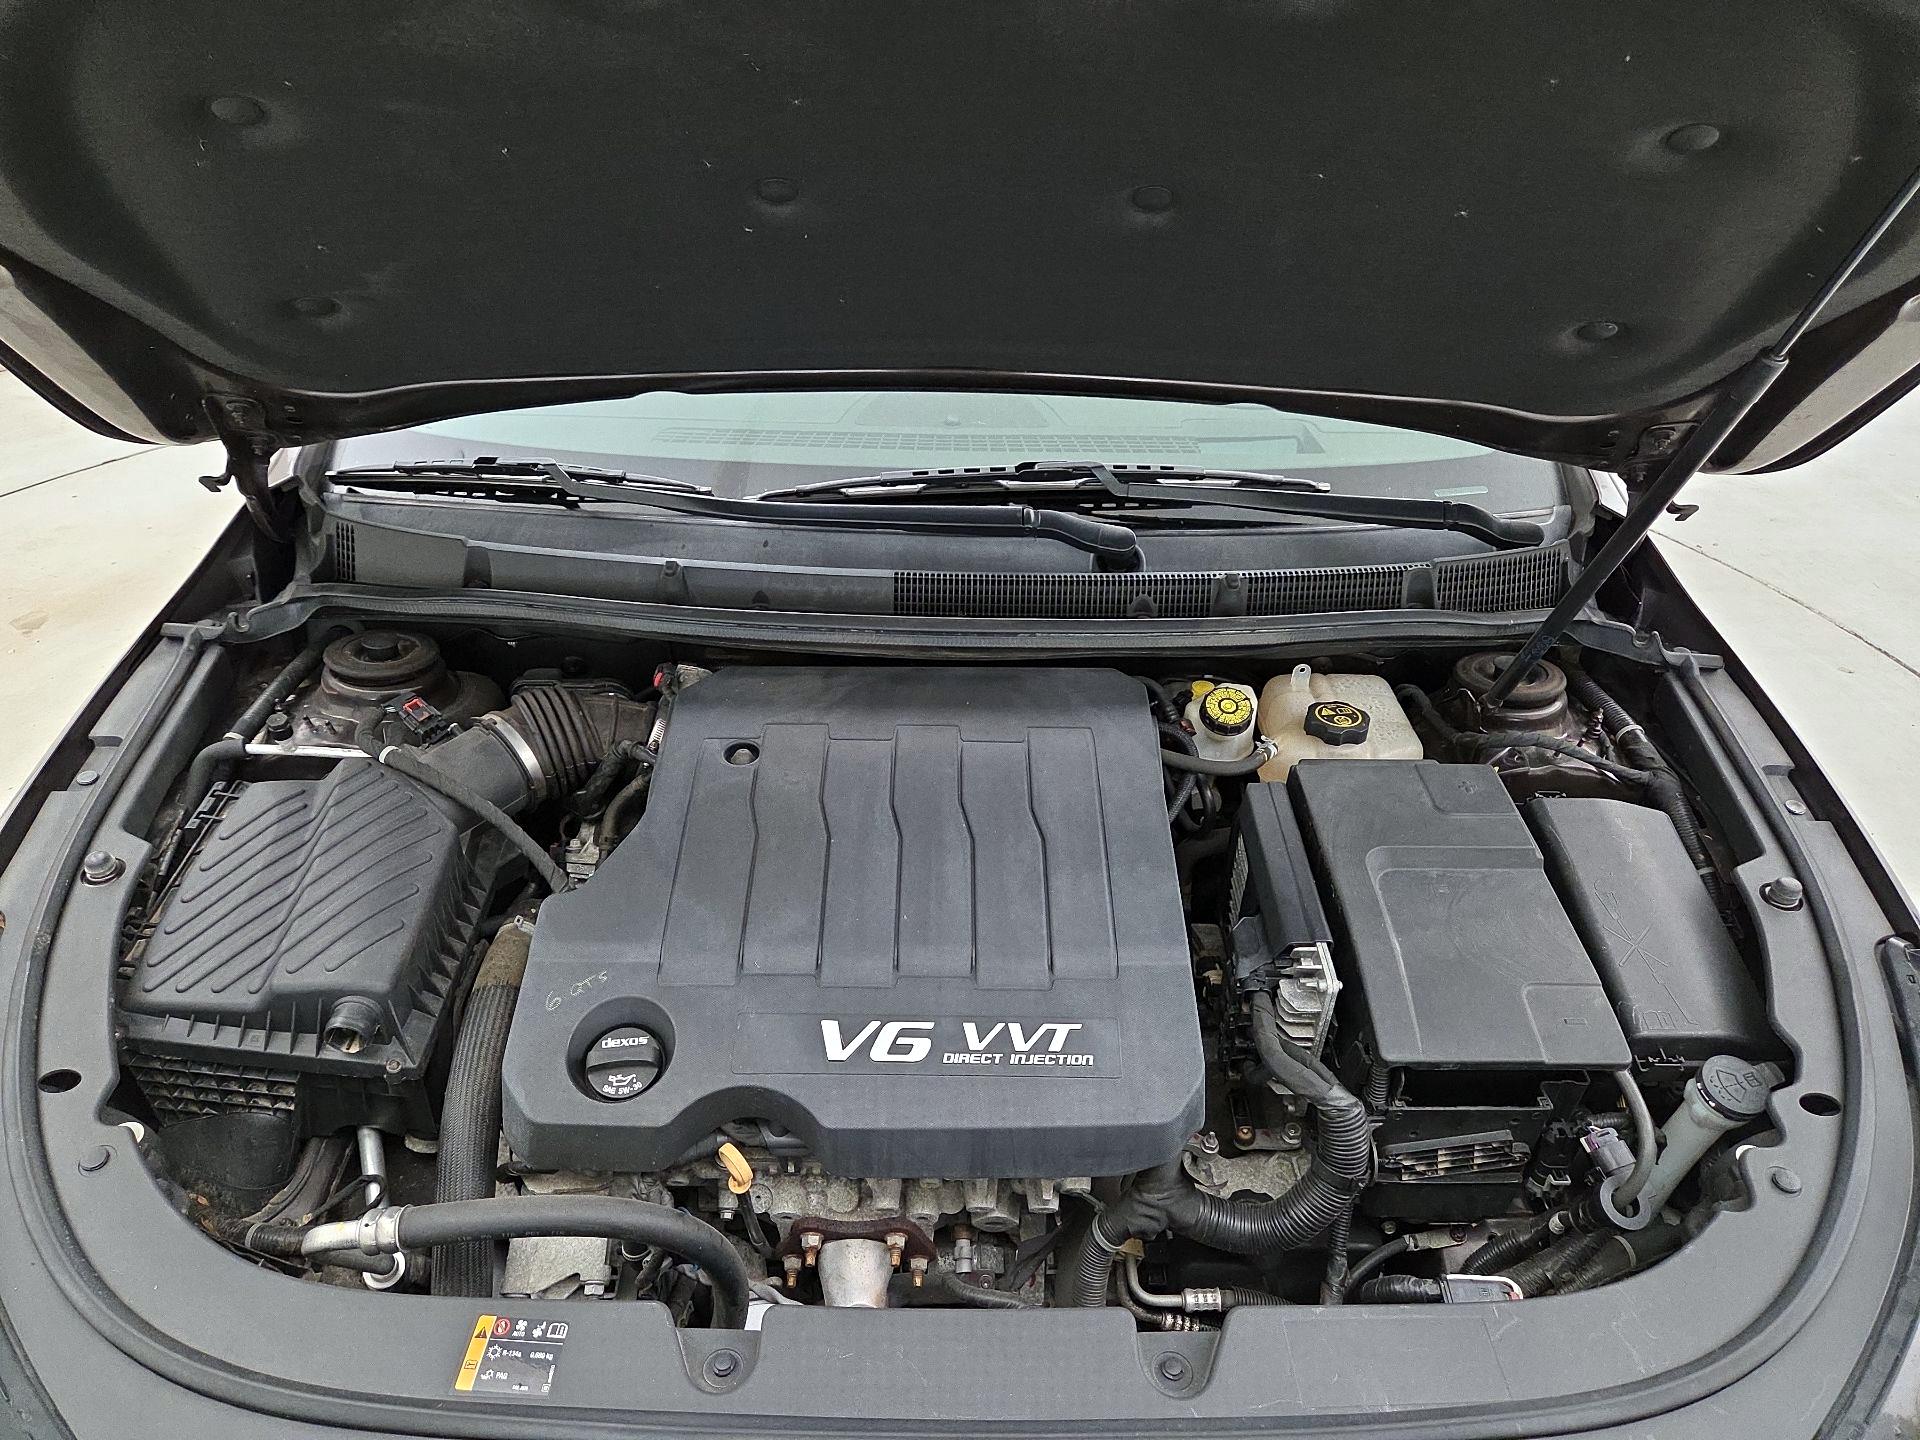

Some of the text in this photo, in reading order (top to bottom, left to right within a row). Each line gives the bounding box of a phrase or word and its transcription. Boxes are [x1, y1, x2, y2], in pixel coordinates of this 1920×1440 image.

[601, 1035, 650, 1049] dexos
[819, 1019, 1083, 1063] V6 VVT
[942, 1052, 1094, 1067] DIRECT INJECTION
[602, 1081, 643, 1095] SAE 5W-30
